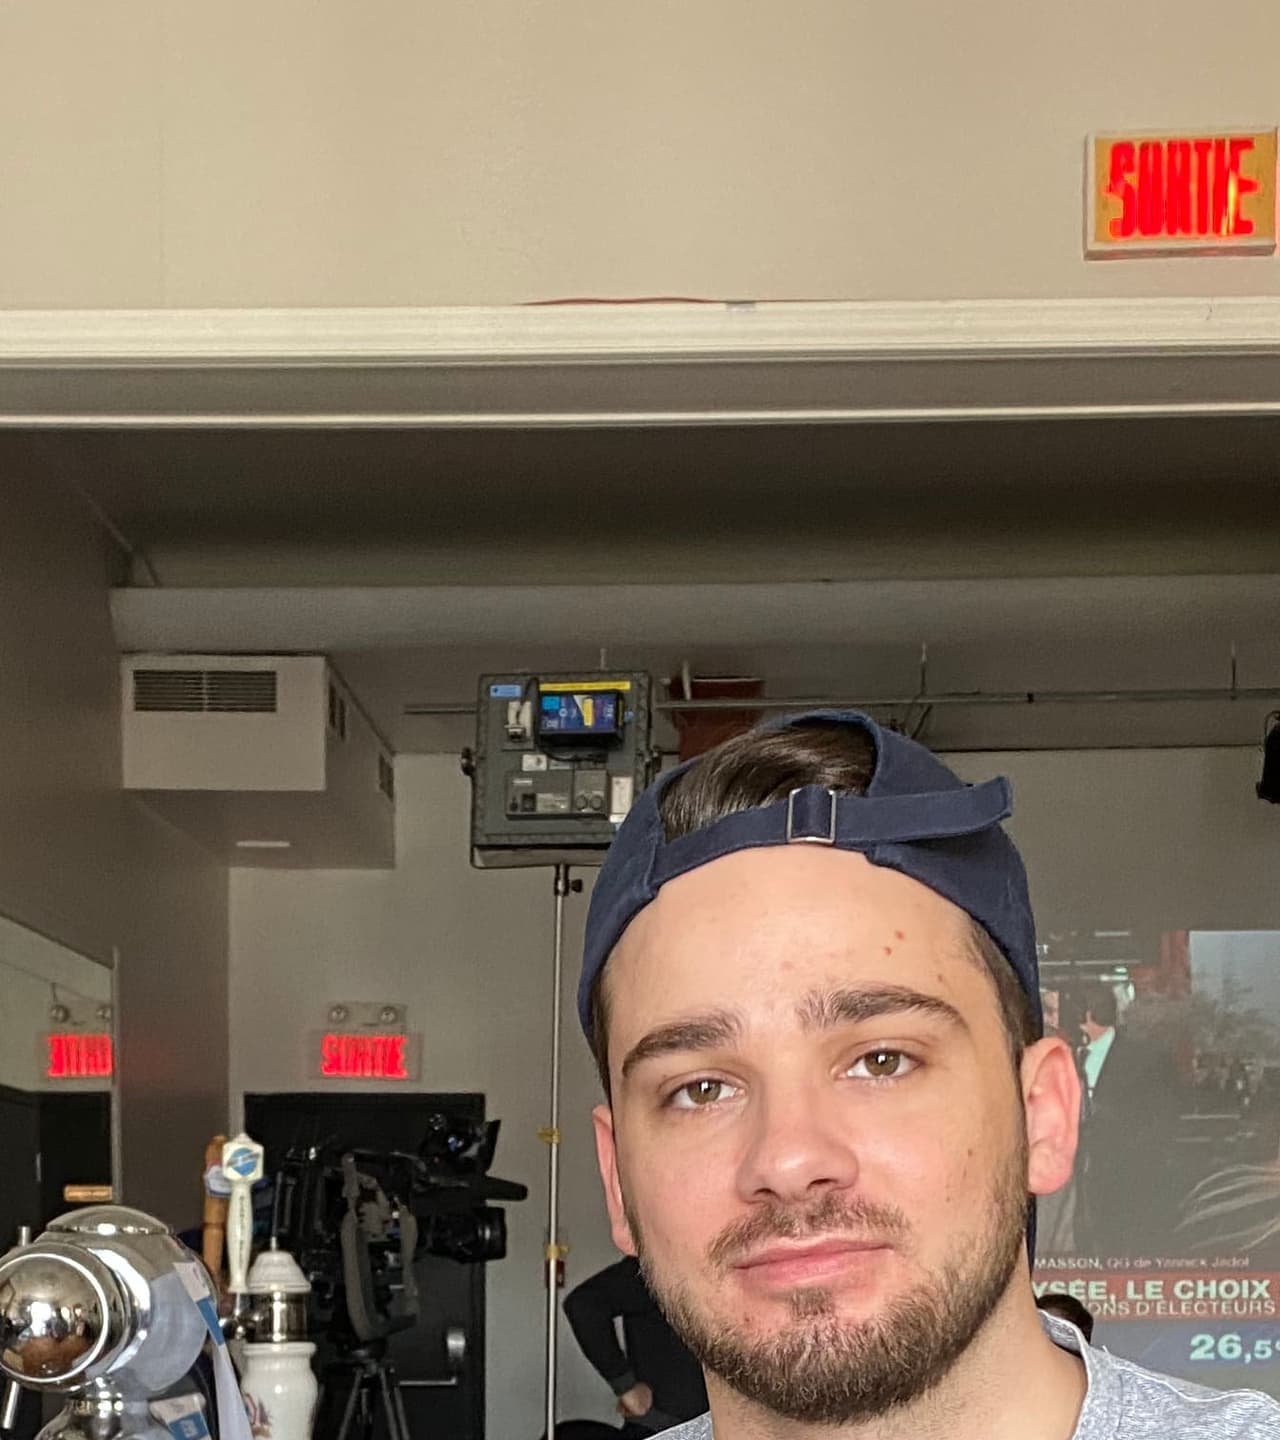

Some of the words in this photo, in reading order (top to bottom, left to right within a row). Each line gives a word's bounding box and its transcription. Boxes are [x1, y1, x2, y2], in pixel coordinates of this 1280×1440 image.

[1107, 137, 1259, 238] SORTIE
[1127, 1280, 1168, 1299] LE
[1173, 1279, 1270, 1299] CHOIX
